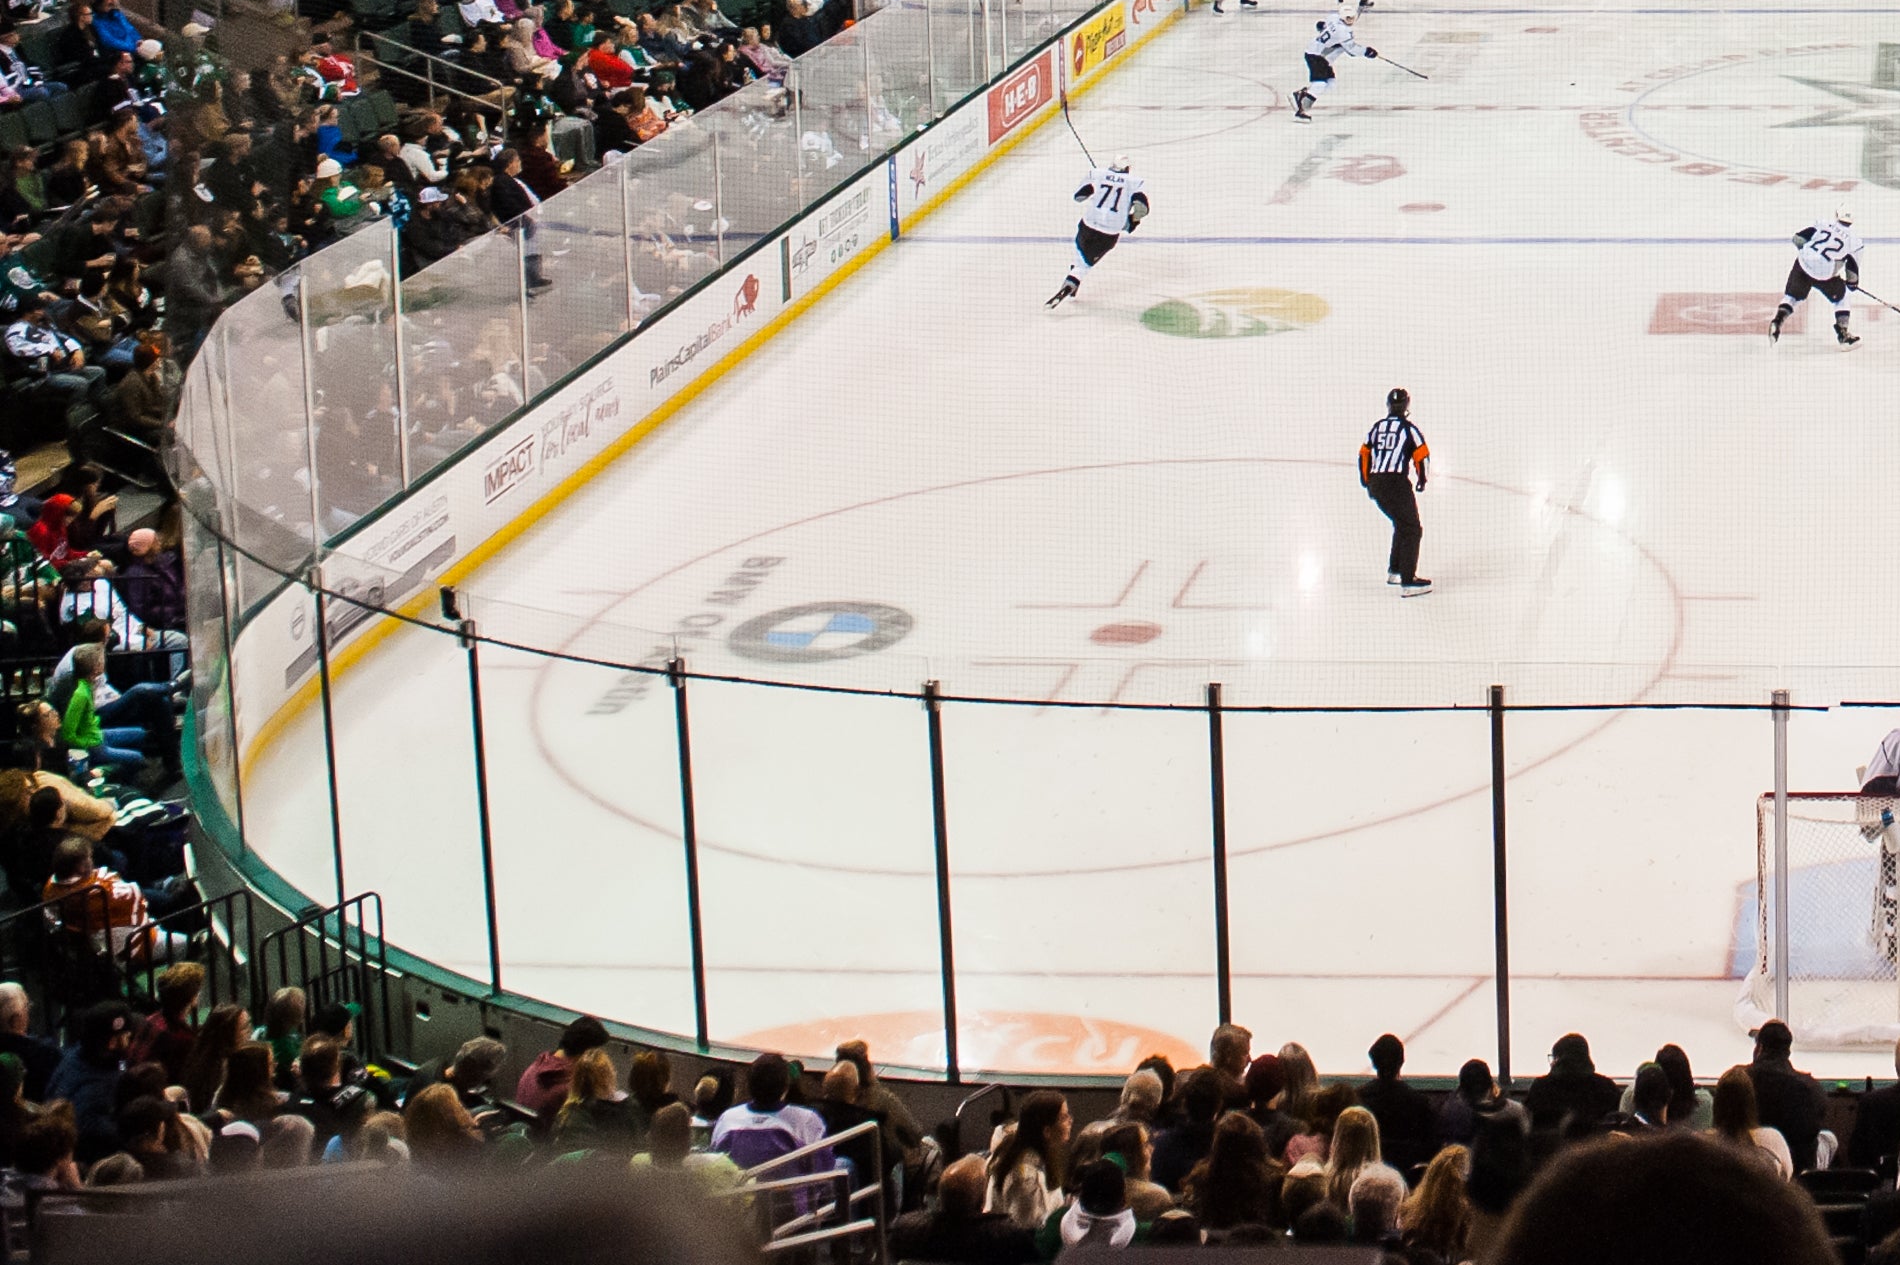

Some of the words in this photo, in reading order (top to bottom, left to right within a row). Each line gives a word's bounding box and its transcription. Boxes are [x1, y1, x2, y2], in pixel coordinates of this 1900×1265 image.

[1004, 73, 1038, 118] H-E-B
[1096, 184, 1123, 213] 71
[1810, 230, 1844, 262] 22
[1376, 432, 1397, 450] 50
[484, 441, 535, 498] IMPACT
[705, 556, 788, 606] BMW
